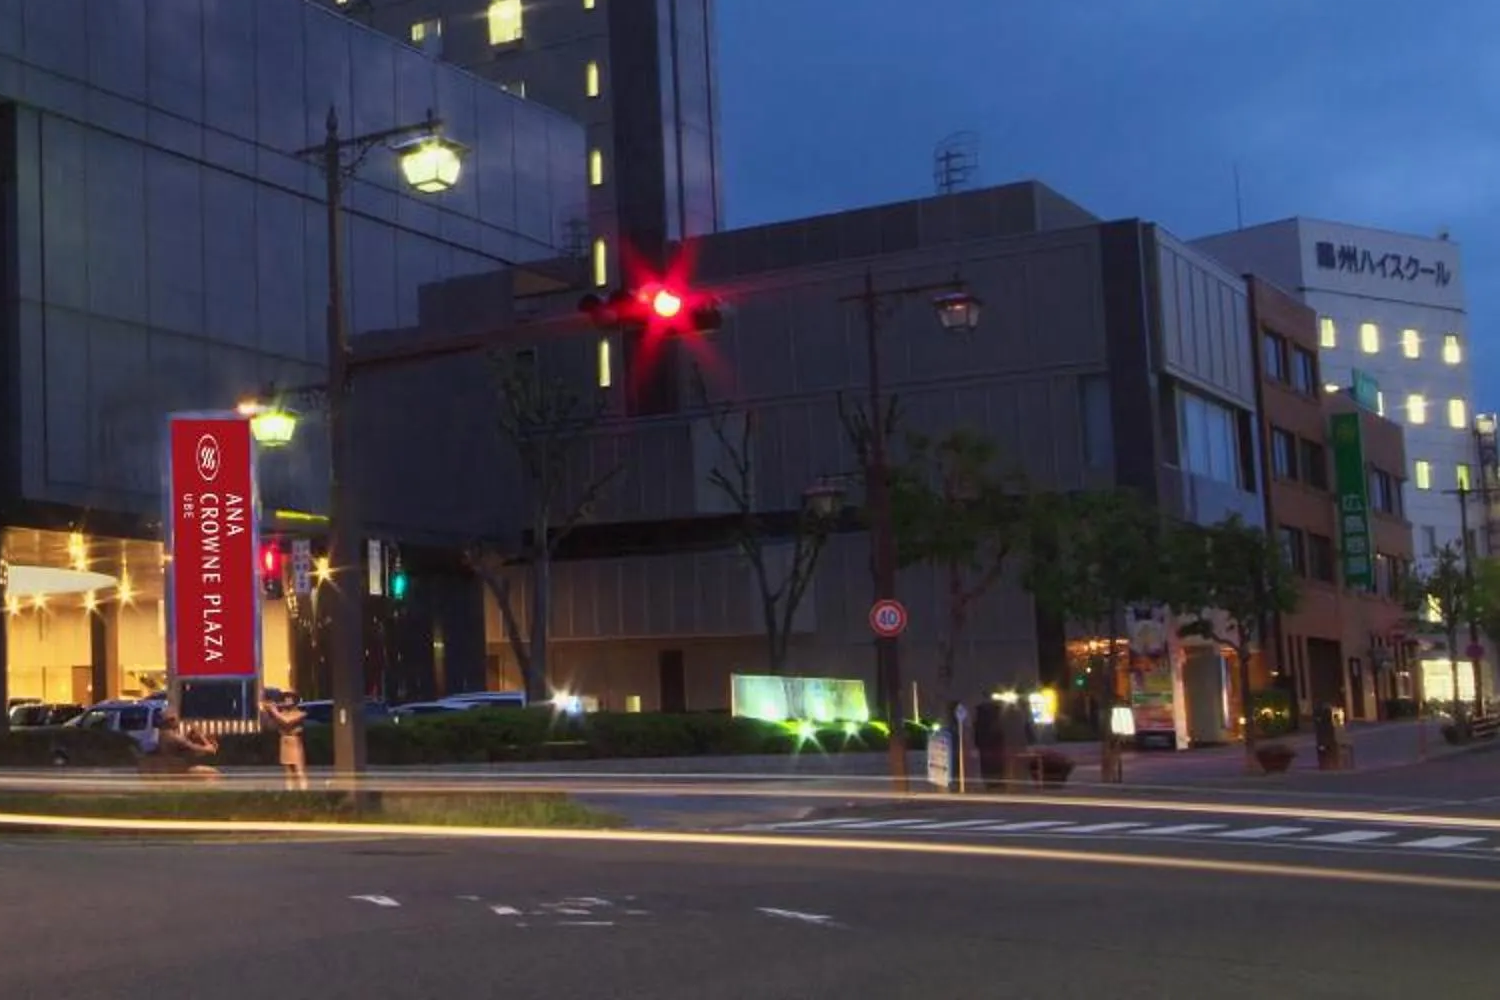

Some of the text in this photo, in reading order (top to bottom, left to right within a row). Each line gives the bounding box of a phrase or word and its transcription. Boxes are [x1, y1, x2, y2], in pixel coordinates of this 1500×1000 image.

[183, 493, 195, 519] UBE
[225, 493, 245, 537] ANA
[199, 493, 223, 662] CROWNE PLAZA
[879, 609, 897, 625] 40
